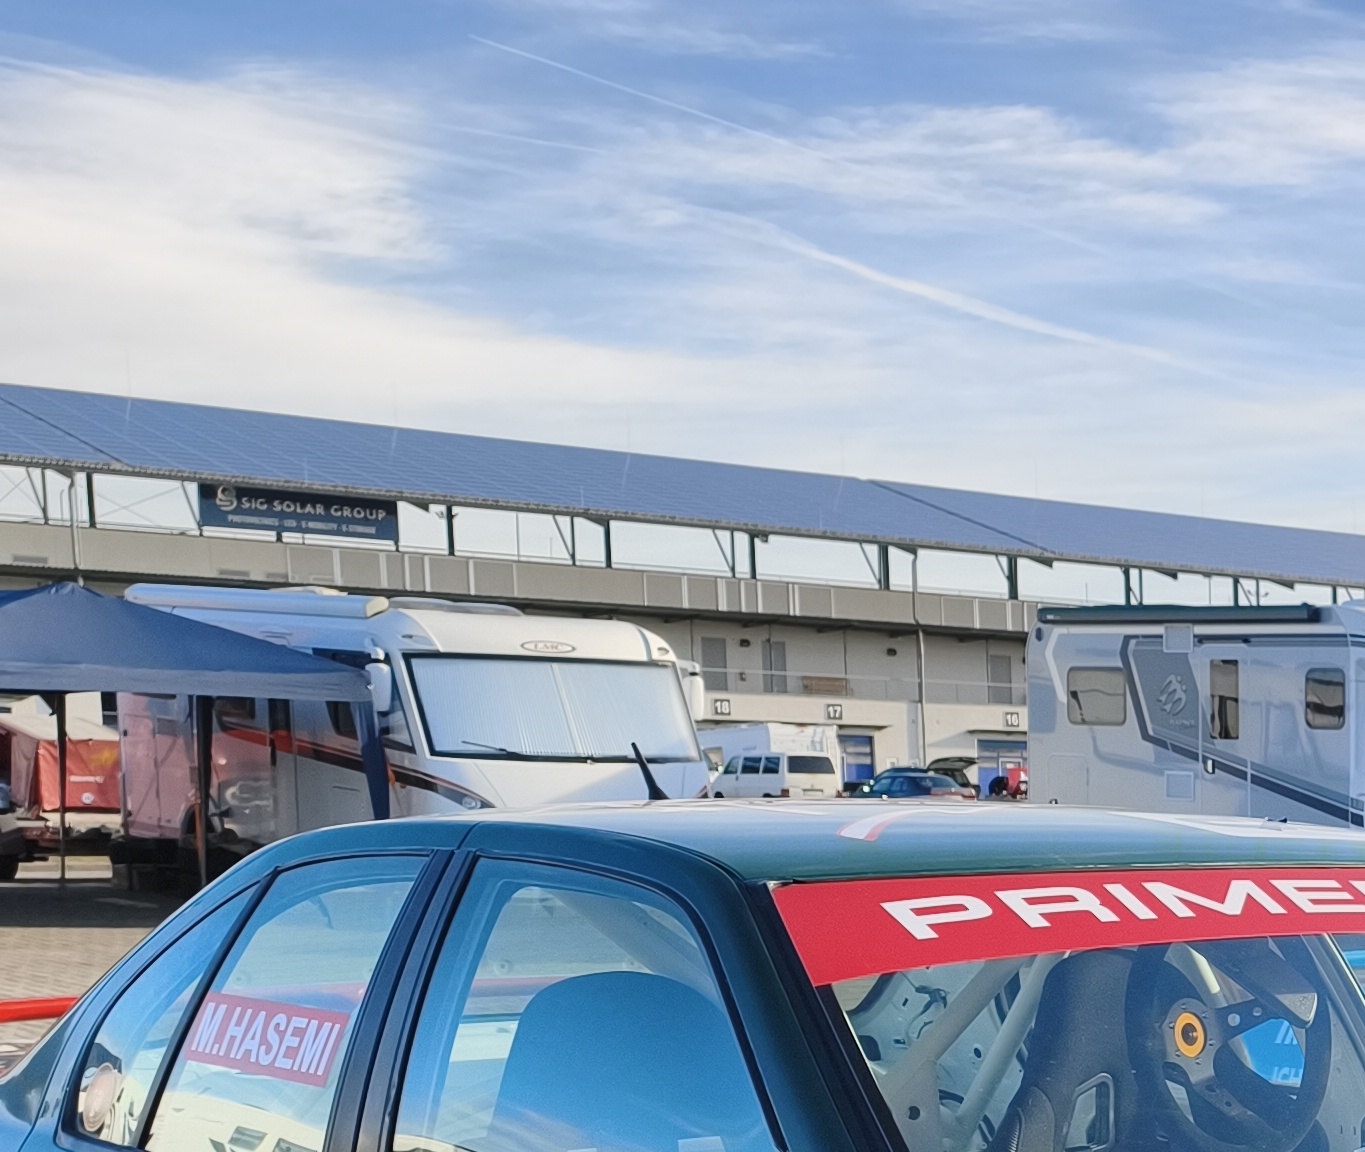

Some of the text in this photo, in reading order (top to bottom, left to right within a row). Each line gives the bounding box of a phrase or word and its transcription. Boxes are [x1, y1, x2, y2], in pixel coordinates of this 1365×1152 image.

[241, 497, 387, 521] SIG SOLAR GROUP
[714, 701, 730, 714] 18
[827, 704, 842, 718] 17
[195, 1002, 341, 1076] M.HASEMI
